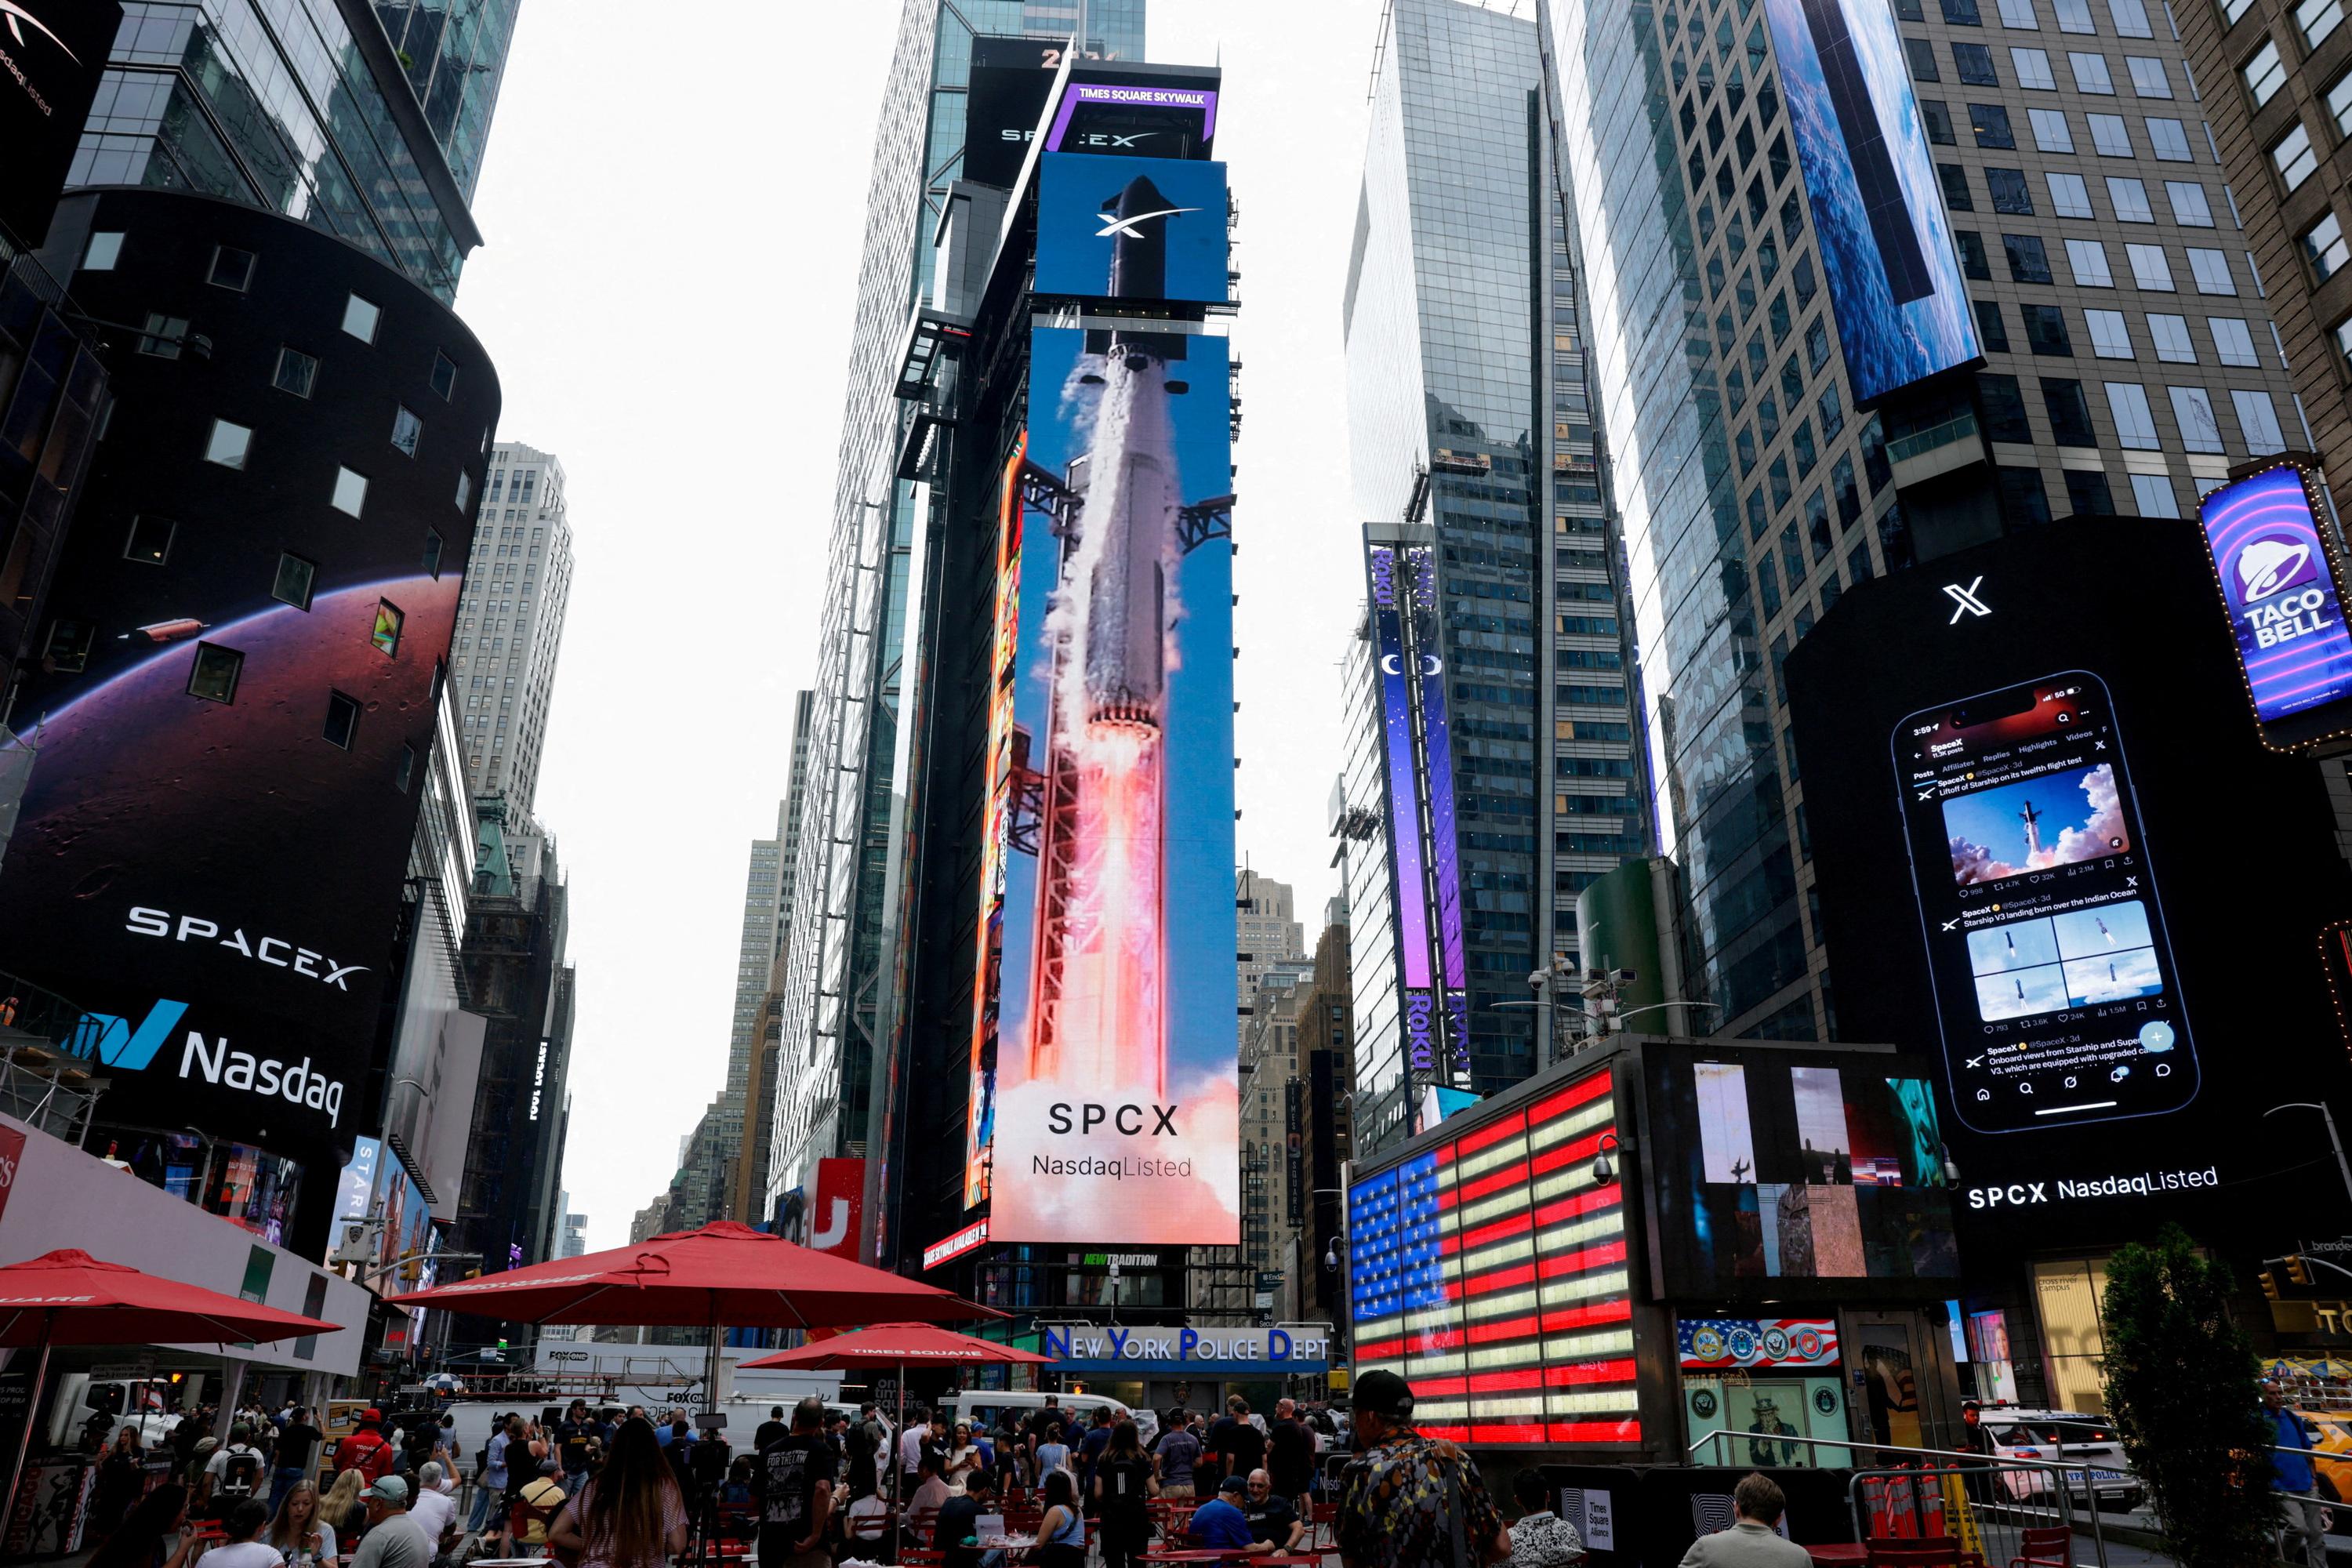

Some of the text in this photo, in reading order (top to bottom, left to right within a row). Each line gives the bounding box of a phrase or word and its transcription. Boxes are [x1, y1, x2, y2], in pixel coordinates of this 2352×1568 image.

[1080, 88, 1204, 104] TIMES SQUARE SKYWALK
[1372, 550, 1393, 604] ROKU
[2244, 588, 2325, 631] TACO
[2256, 607, 2333, 650] BELL
[1913, 726, 1932, 735] 3:59
[1931, 738, 1963, 753] SpaceX
[1947, 746, 1964, 756] posts
[1914, 770, 1934, 780] Posts
[1942, 760, 1975, 772] Affiliates
[1983, 751, 2010, 763] Replies
[2019, 739, 2057, 753] Highlights
[2066, 731, 2093, 742] Videos
[1937, 775, 1965, 787] SpaceX
[1976, 764, 2009, 777] @SpaceX
[1939, 786, 1960, 797] Liftoff
[1969, 777, 1999, 789] Starship
[2021, 764, 2047, 776] twelfth
[2047, 760, 2067, 771] flight
[2067, 757, 2082, 765] test
[2042, 873, 2056, 881] 32K
[2078, 865, 2095, 873] 2.1M
[1969, 887, 1984, 895] 998
[2005, 880, 2020, 888] 4.7K
[1962, 906, 1991, 919] SpaceX
[2002, 897, 2038, 910] @SpaceX
[1964, 887, 2137, 928] Starship V3 landing burn over the Indian Ocean
[125, 906, 372, 991] SPACEX
[2070, 1012, 2085, 1021] 24K
[2109, 1006, 2126, 1015] 1.5M
[1407, 995, 1433, 1069] ROKU
[1995, 1024, 2009, 1033] 793
[1987, 1044, 2017, 1056] SpaceX
[2029, 1036, 2066, 1050] @SpaceX
[1989, 1037, 2141, 1066] Onboard views from Starship and Super
[1991, 1066, 2005, 1076] V3,
[2005, 1063, 2028, 1074] which
[2028, 1062, 2042, 1070] are
[2042, 1055, 2078, 1069] equipped
[2079, 1053, 2098, 1063] with
[2099, 1048, 2137, 1062] upgraded
[179, 1030, 343, 1129] Nasdaq
[1047, 1102, 1178, 1136] SPCX
[1032, 1154, 1192, 1180] NasdaqListed
[1969, 1166, 2219, 1209] SPCX NasdaqListed
[550, 1351, 569, 1360] FOX
[667, 1392, 690, 1403] FOX
[768, 1454, 807, 1467] FOR THE LAW
[2091, 1471, 2121, 1480] POLICE
[1590, 1501, 1607, 1514] Times
[1589, 1513, 1609, 1526] Square
[1591, 1526, 1609, 1537] Alliance
